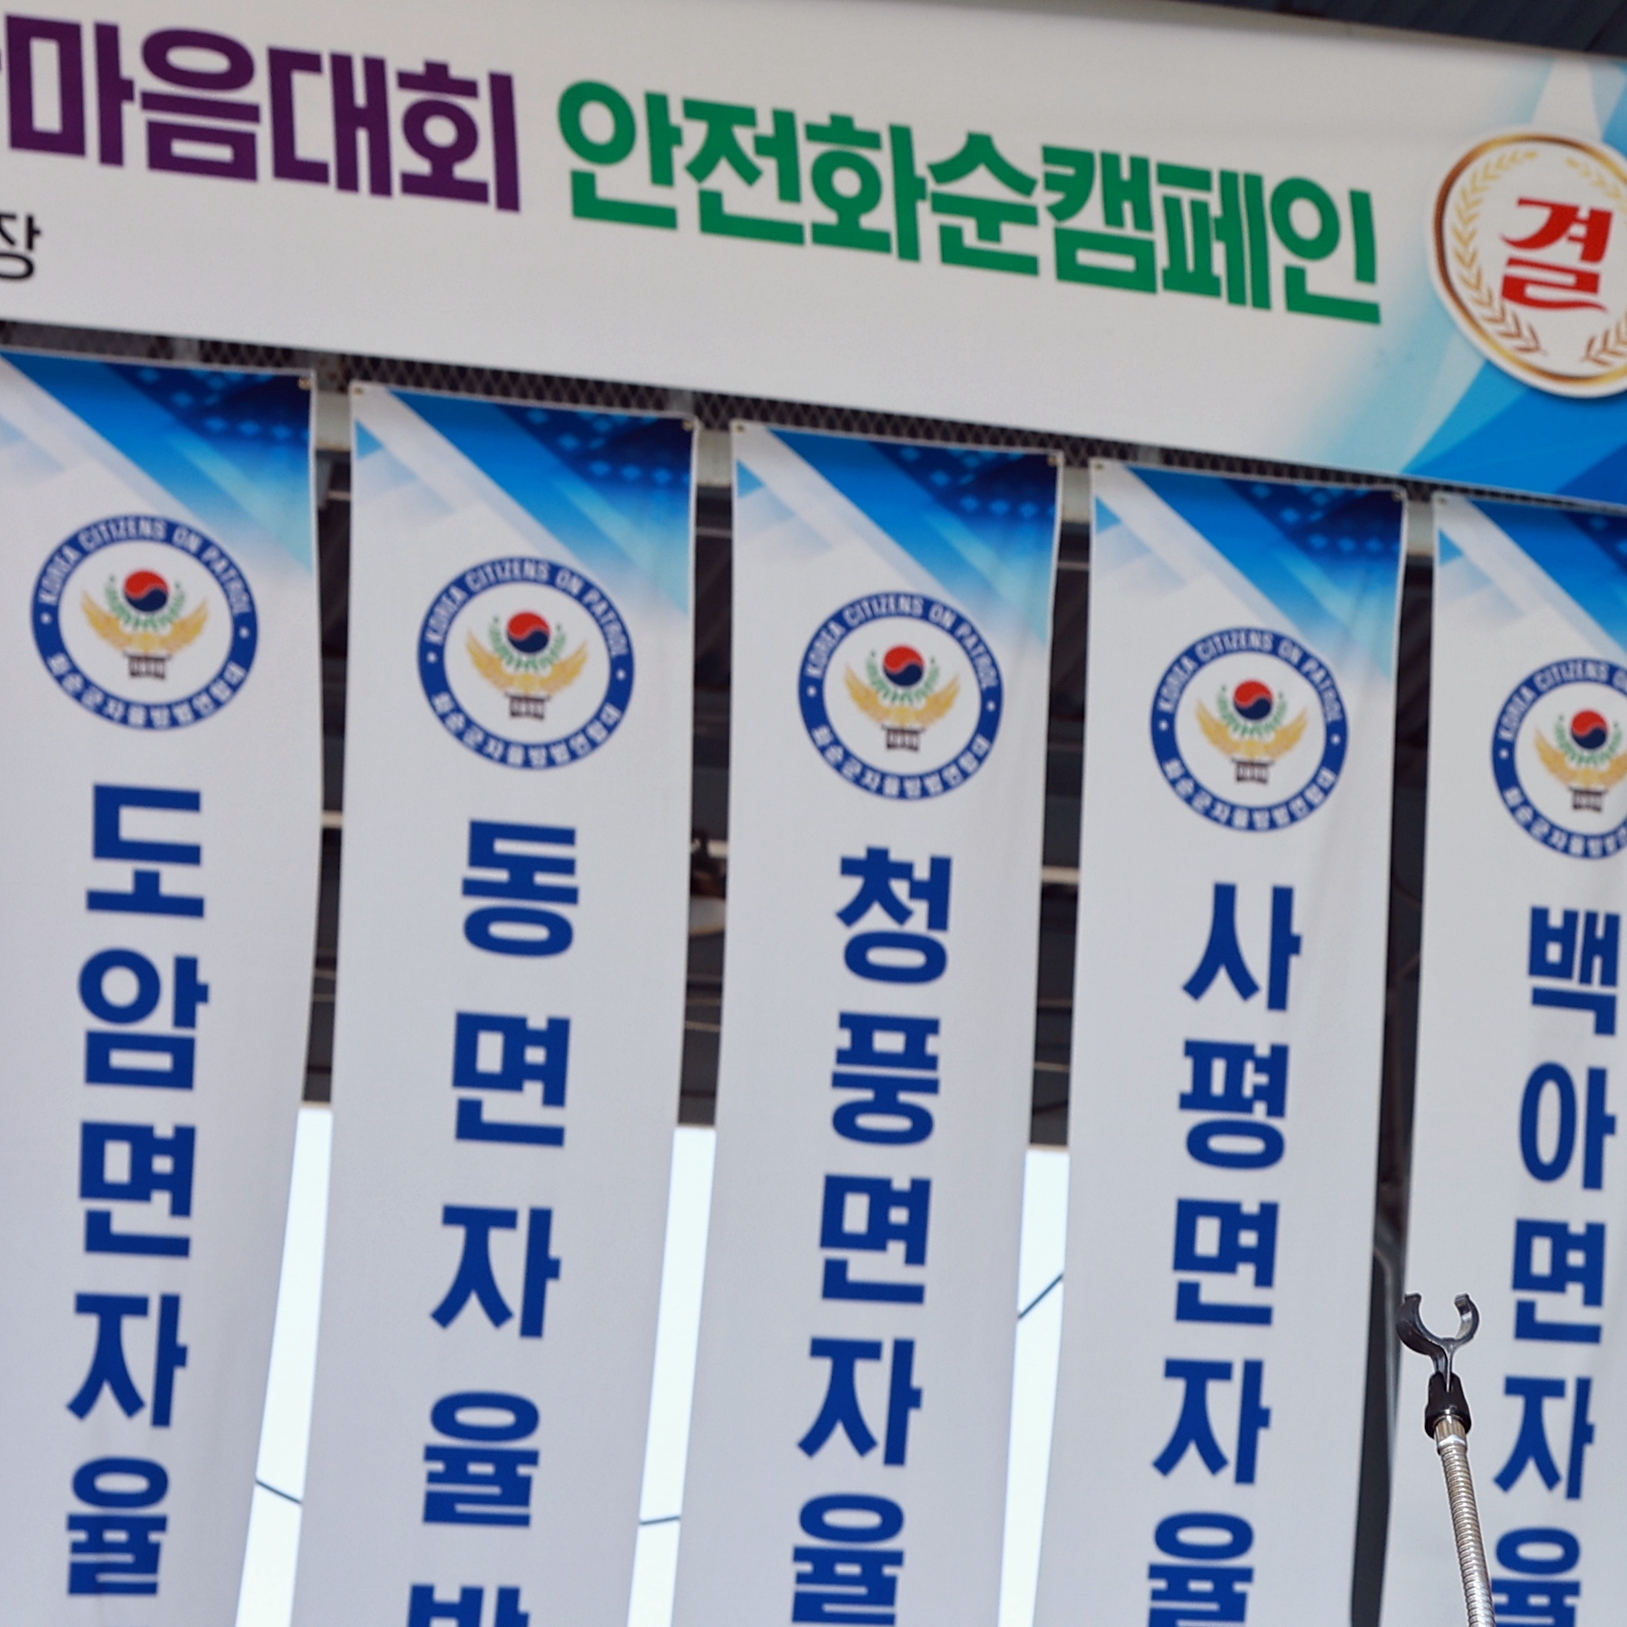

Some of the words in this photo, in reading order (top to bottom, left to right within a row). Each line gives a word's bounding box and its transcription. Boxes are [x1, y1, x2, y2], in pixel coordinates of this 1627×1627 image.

[0, 14, 520, 213] 마음대회
[559, 80, 1382, 325] 안전화순캠페인
[1502, 198, 1612, 312] 결
[39, 545, 81, 606] KOREA
[78, 515, 167, 550] CITIZENS
[173, 525, 202, 553] ON
[201, 545, 250, 615] PATROL
[425, 584, 468, 646] KOREA
[464, 558, 550, 591] CITIZENS
[555, 568, 584, 595] ON
[583, 588, 628, 658] PATROL
[805, 621, 846, 679] KOREA
[843, 595, 924, 627] CITIZENS
[929, 604, 957, 629] ON
[955, 623, 999, 690] PATROL
[1158, 655, 1199, 713] KOREA
[1195, 630, 1274, 662] CITIZENS
[1278, 639, 1304, 664] ON
[1533, 660, 1609, 691] CITIZENS
